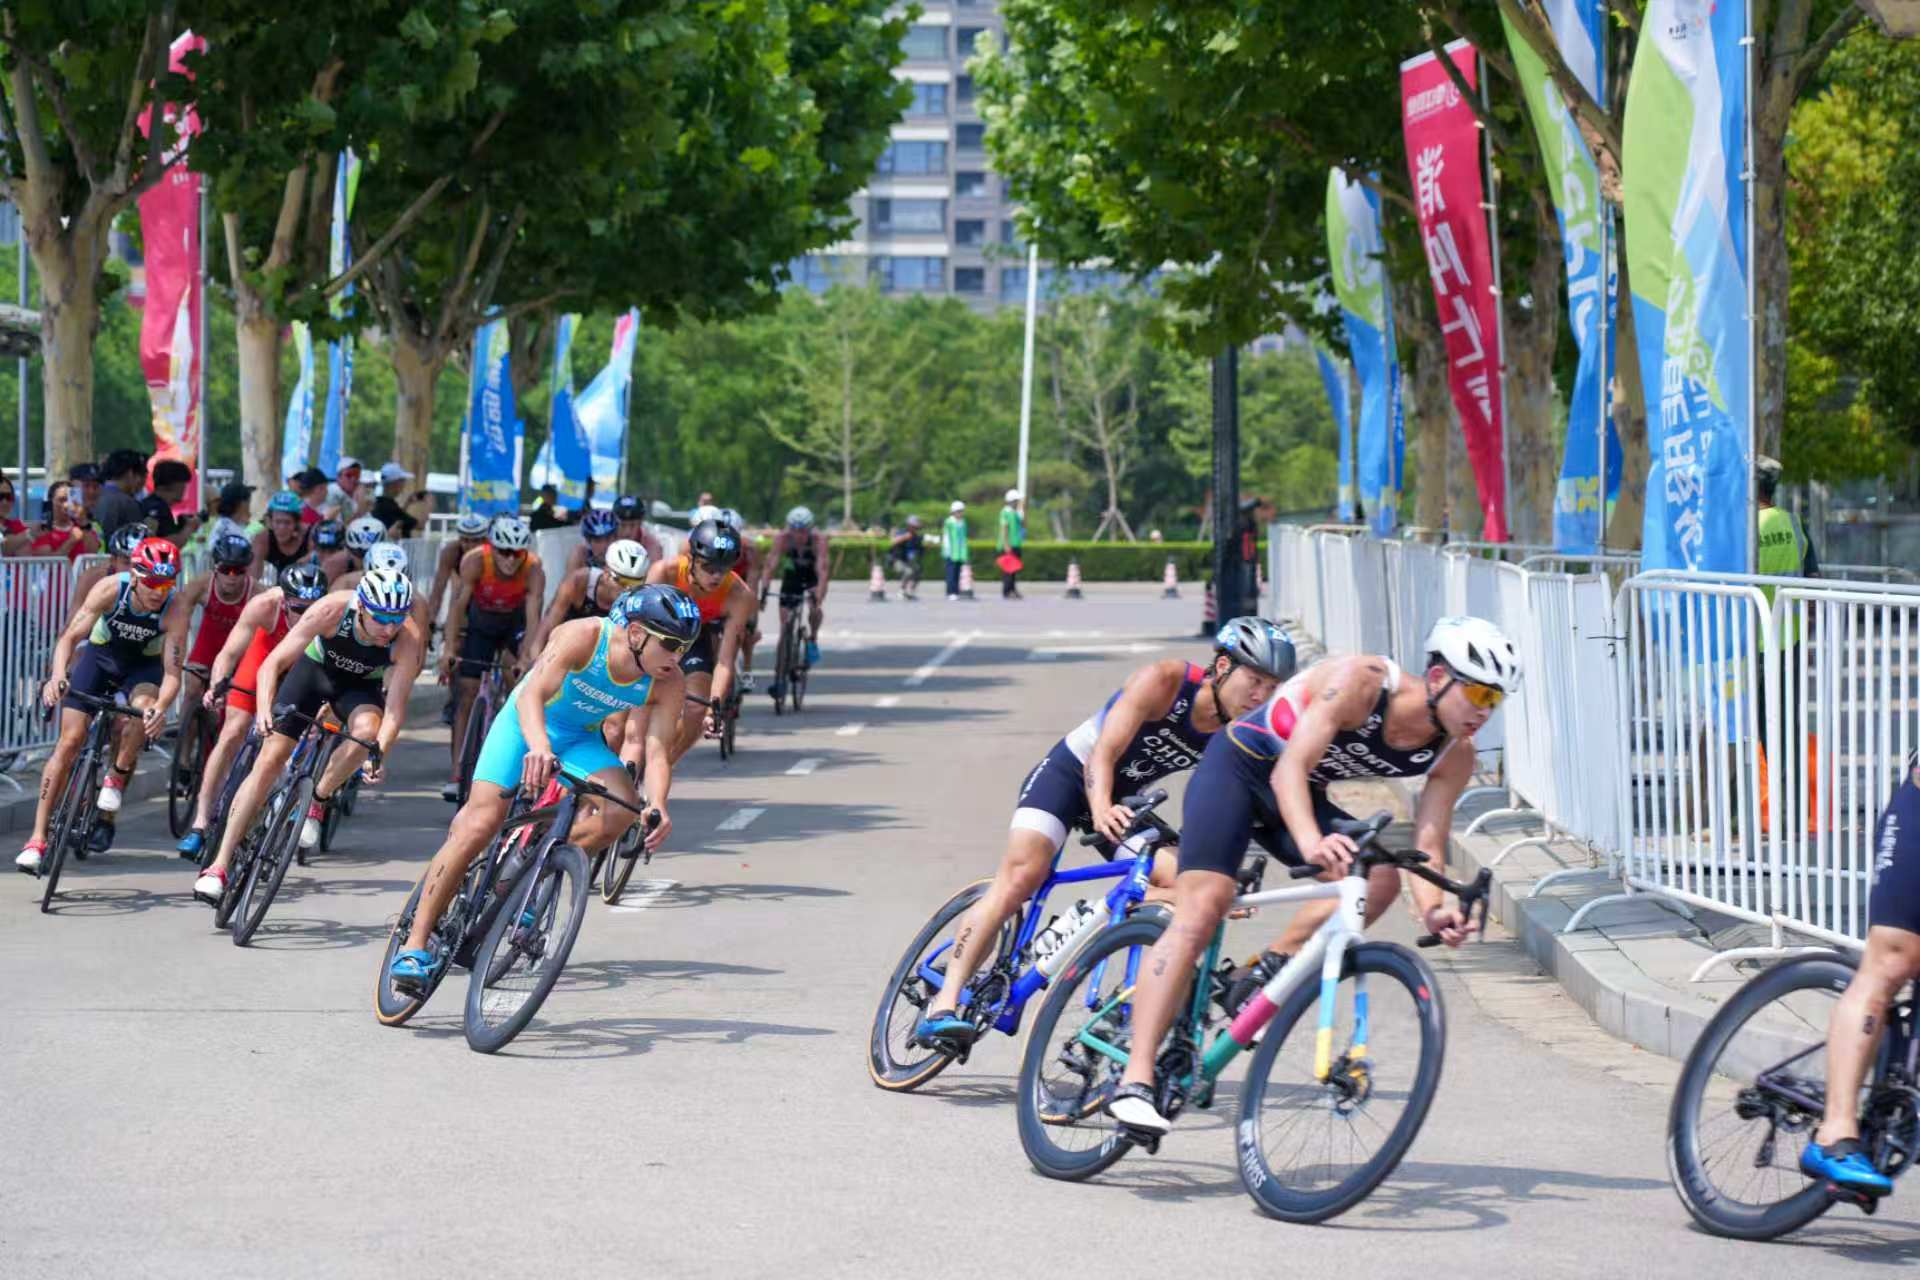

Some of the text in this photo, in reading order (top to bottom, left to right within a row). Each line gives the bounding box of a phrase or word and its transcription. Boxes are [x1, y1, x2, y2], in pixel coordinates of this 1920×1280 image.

[679, 597, 694, 618] 11
[111, 619, 157, 636] TEMIROV
[119, 630, 145, 641] KAZ
